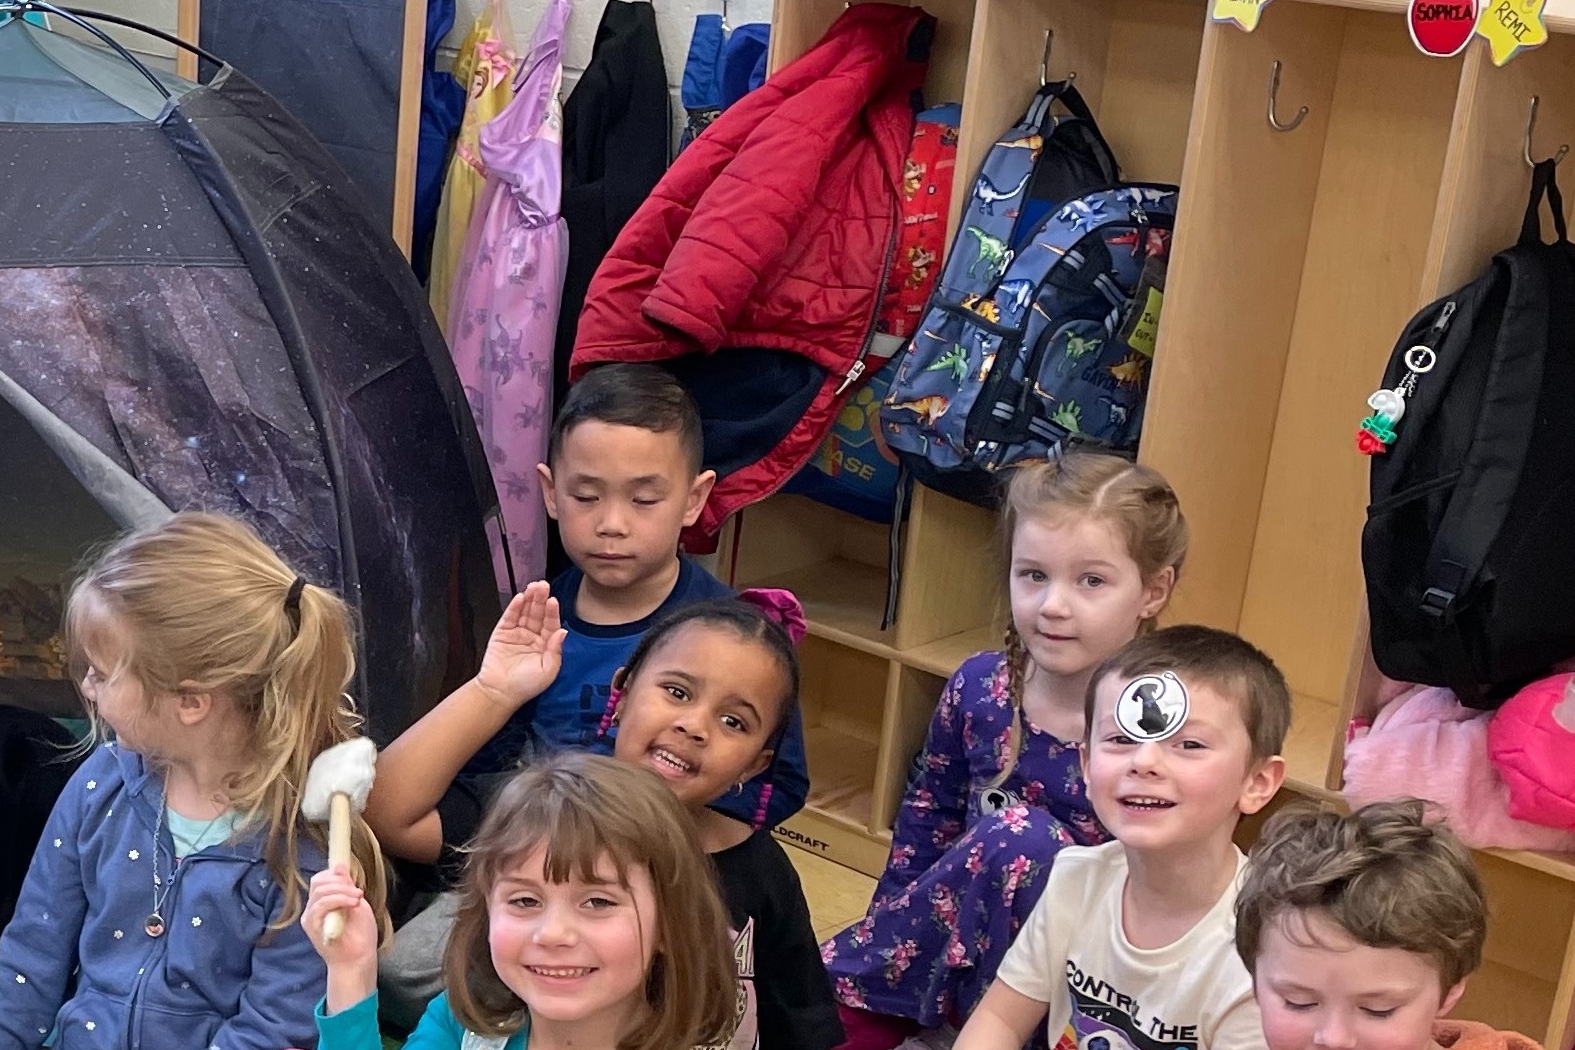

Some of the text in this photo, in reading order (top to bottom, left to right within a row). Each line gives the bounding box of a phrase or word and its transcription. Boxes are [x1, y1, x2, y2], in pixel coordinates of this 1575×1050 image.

[1416, 3, 1473, 21] SOPHIA
[1494, 1, 1531, 42] REMI
[771, 825, 829, 851] LDCRAFT
[1066, 959, 1198, 1041] CONTRL THE
